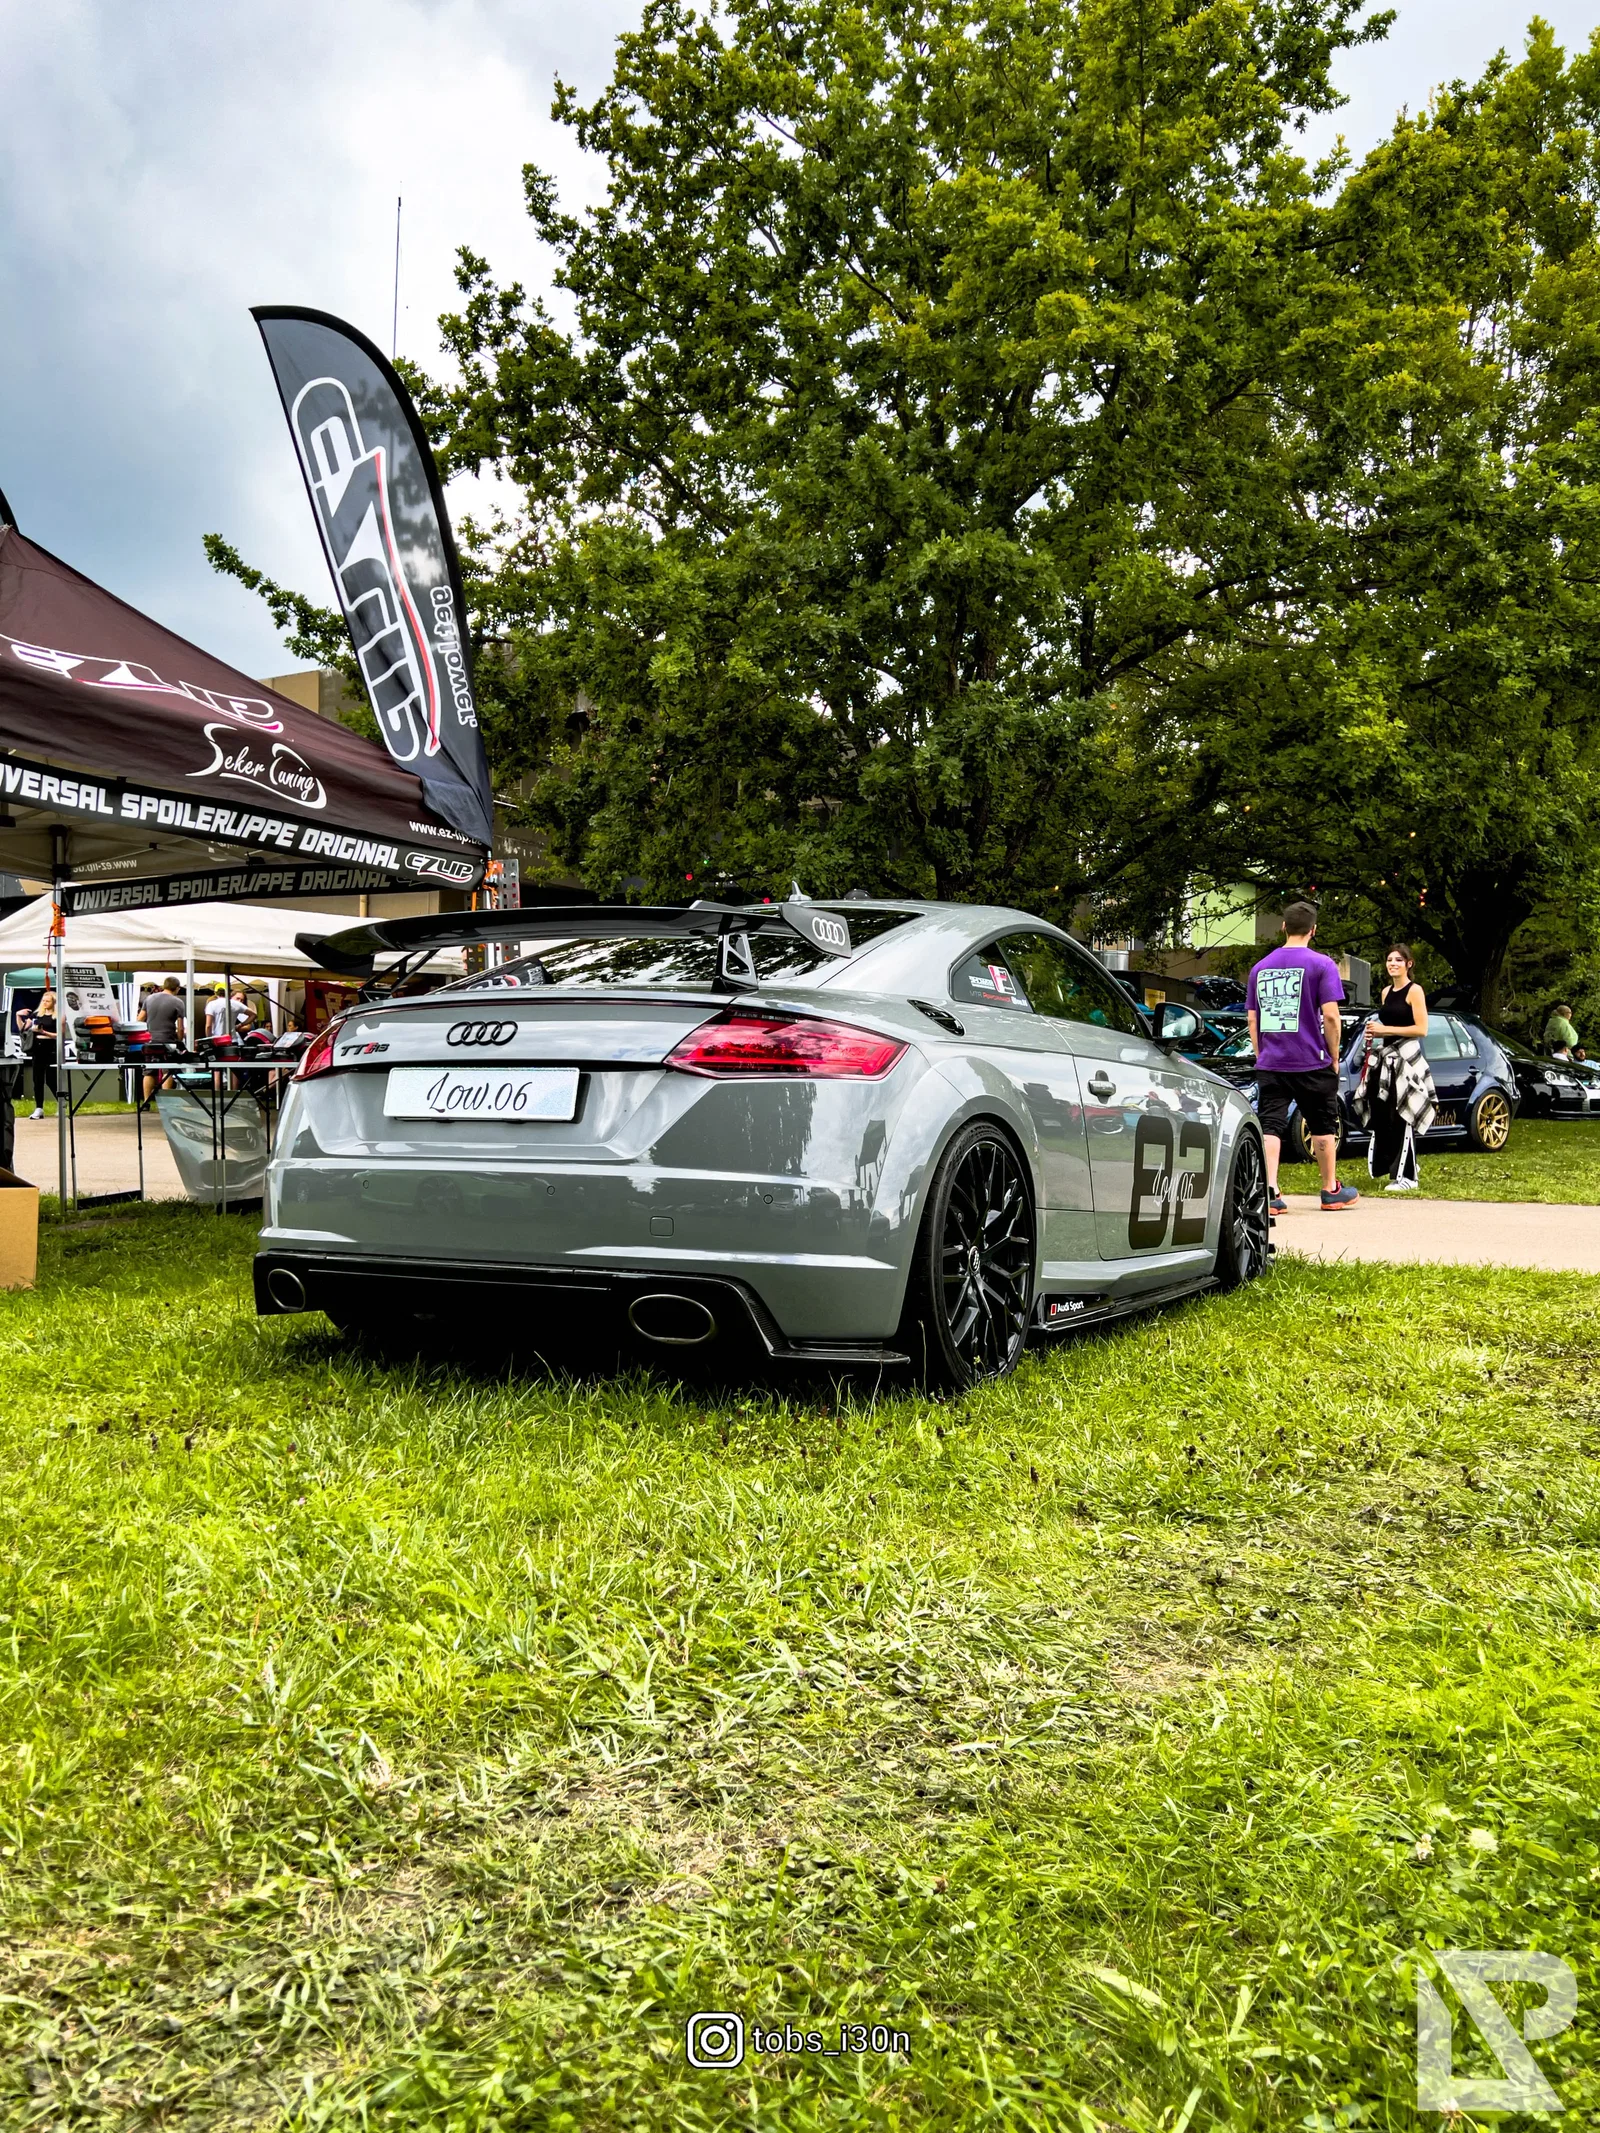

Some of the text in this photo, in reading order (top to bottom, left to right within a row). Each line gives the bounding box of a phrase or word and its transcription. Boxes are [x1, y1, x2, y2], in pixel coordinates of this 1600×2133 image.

[185, 723, 265, 777] Seker
[121, 793, 299, 848] SPOILERLIPPE
[299, 828, 400, 870] ORIGINAL
[405, 852, 474, 883] EZLIP
[73, 884, 164, 911] UNIVERSAL
[168, 872, 296, 901] SPOILERLIPPE
[299, 869, 391, 891] ORIGINAL
[427, 1072, 533, 1113] Low.06
[1057, 1301, 1084, 1312] Audi Sport
